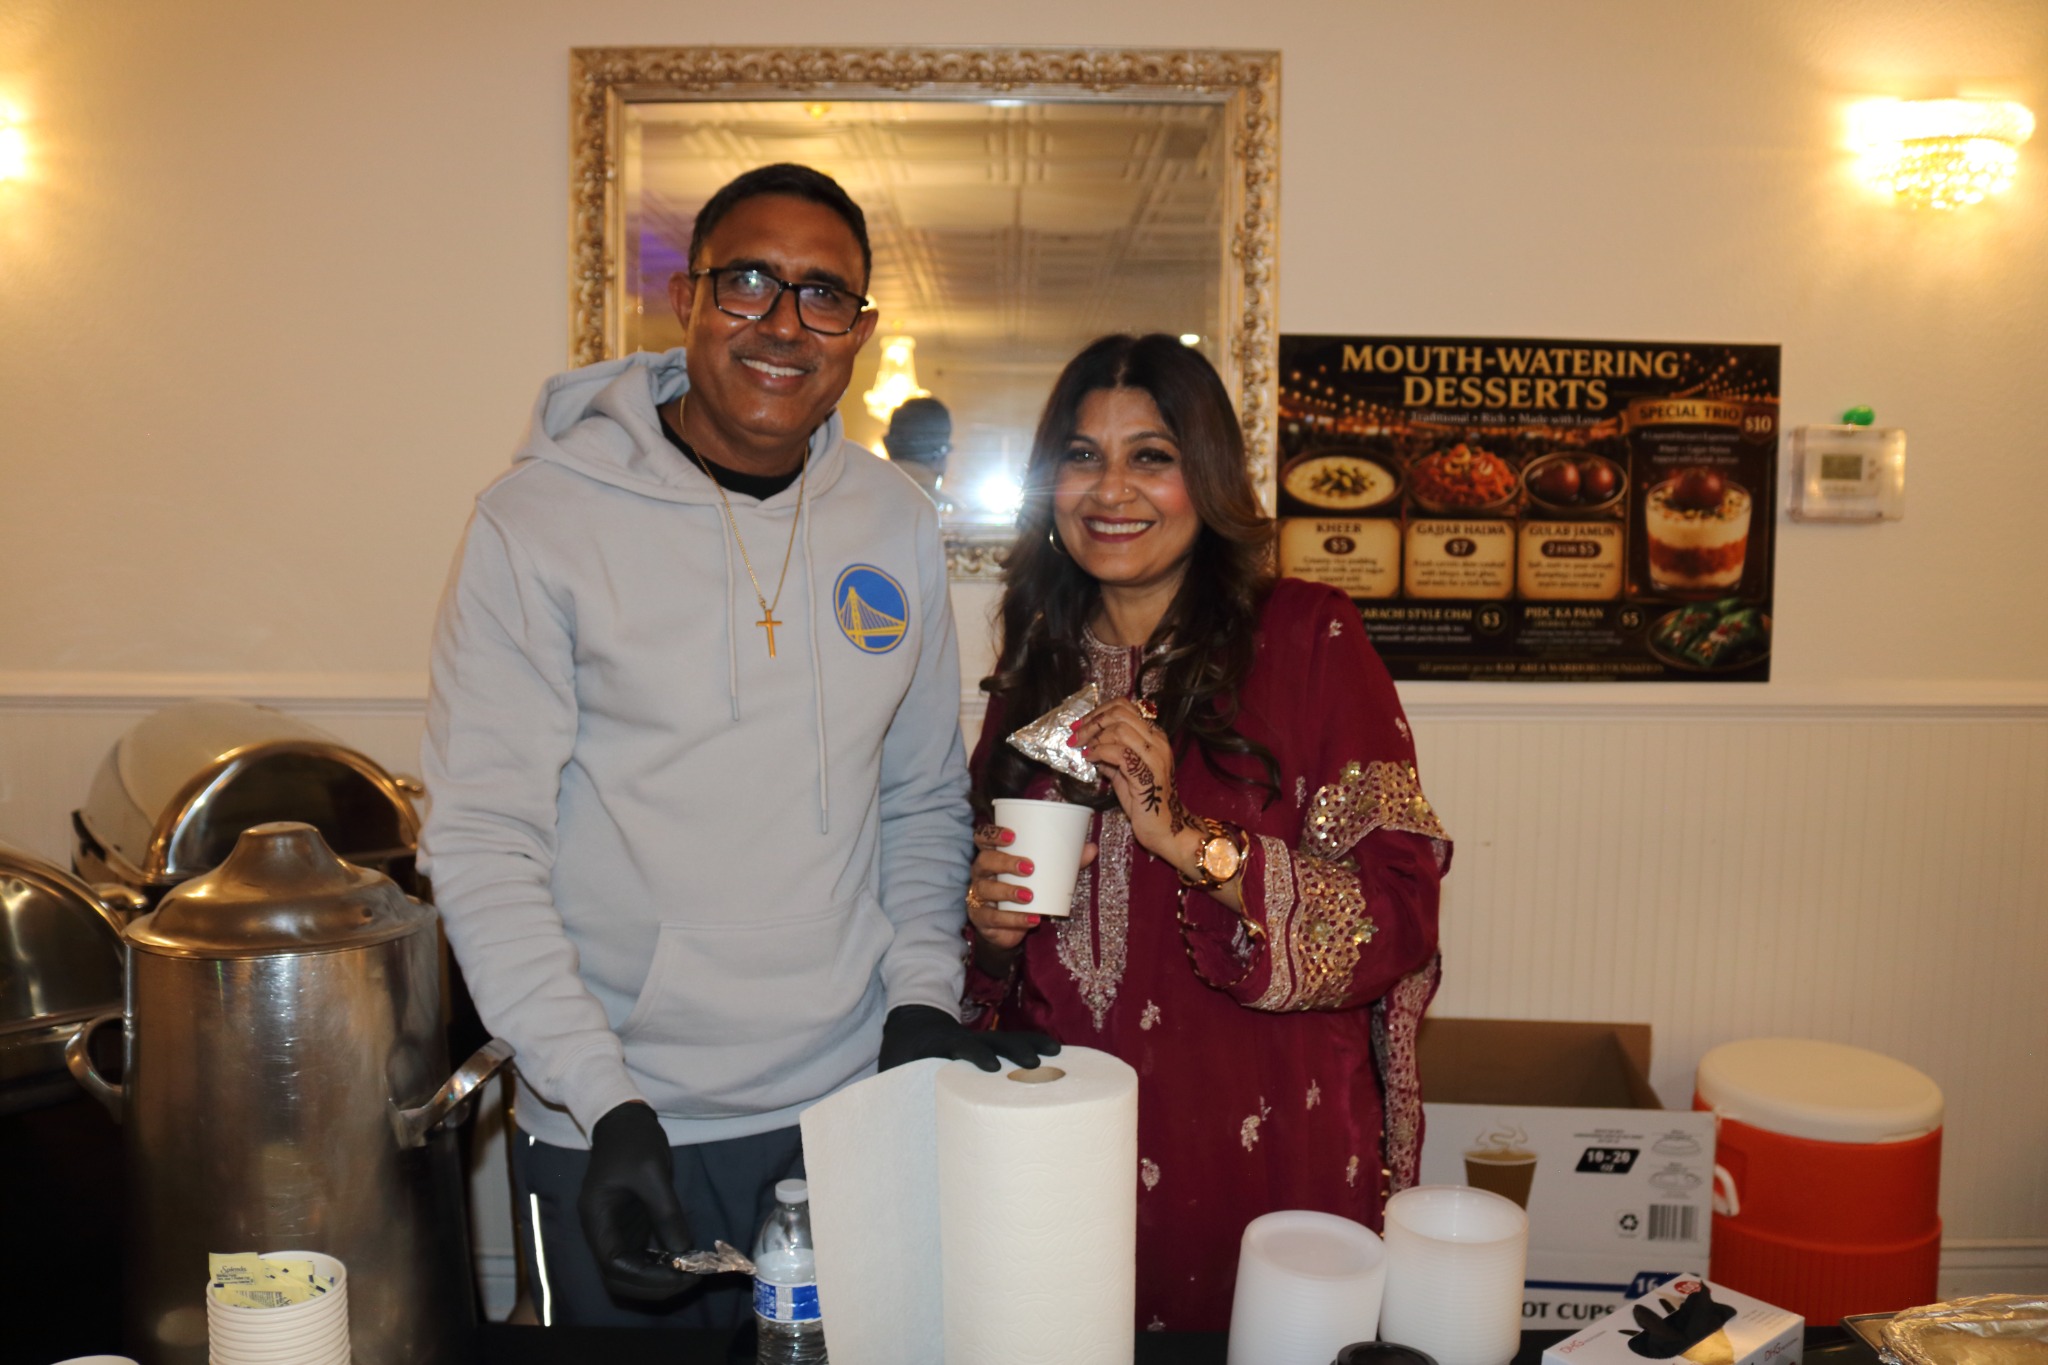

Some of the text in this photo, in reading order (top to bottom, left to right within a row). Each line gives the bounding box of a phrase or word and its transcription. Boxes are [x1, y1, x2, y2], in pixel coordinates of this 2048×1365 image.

[1341, 344, 1679, 378] MOUTH-WATERING
[1403, 375, 1609, 410] DESSERTS
[1410, 410, 1470, 424] Traditional
[1481, 411, 1507, 424] Rich
[1518, 412, 1548, 425] Made
[1551, 412, 1575, 425] with
[1639, 403, 1739, 420] SPECIAL TRIO
[1744, 415, 1772, 433] $10
[1316, 522, 1362, 533] KHEER
[1416, 523, 1506, 536] GAJJAR HALWA
[1529, 525, 1616, 538] GULAB JAMUN
[1330, 538, 1349, 553] $5
[1451, 540, 1470, 555] $7
[1547, 542, 1556, 555] 2
[1579, 542, 1596, 556] $5
[1408, 607, 1441, 620] STYLE
[1444, 608, 1473, 621] CHAI
[1482, 611, 1500, 628] $3
[1556, 607, 1572, 619] KA
[1573, 607, 1605, 619] PAAN
[1622, 611, 1639, 627] $5
[1586, 1149, 1631, 1164] 10-20
[1522, 1301, 1616, 1320] OT CUPS
